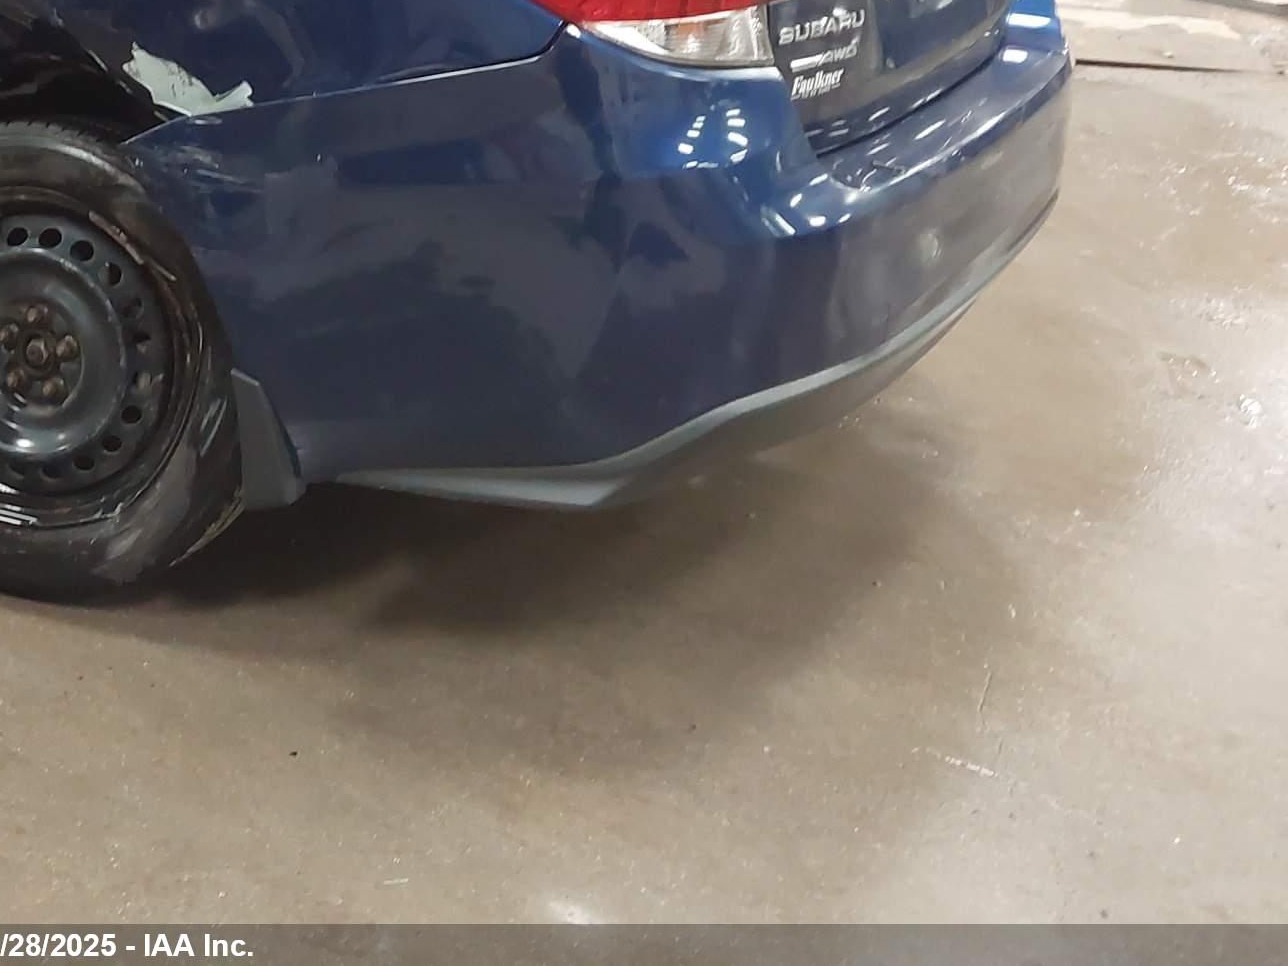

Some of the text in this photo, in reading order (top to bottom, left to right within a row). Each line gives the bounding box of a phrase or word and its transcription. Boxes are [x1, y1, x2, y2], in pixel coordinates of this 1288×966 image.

[778, 8, 865, 46] SUBARU
[817, 42, 859, 66] AWD
[791, 68, 844, 96] Faulkner
